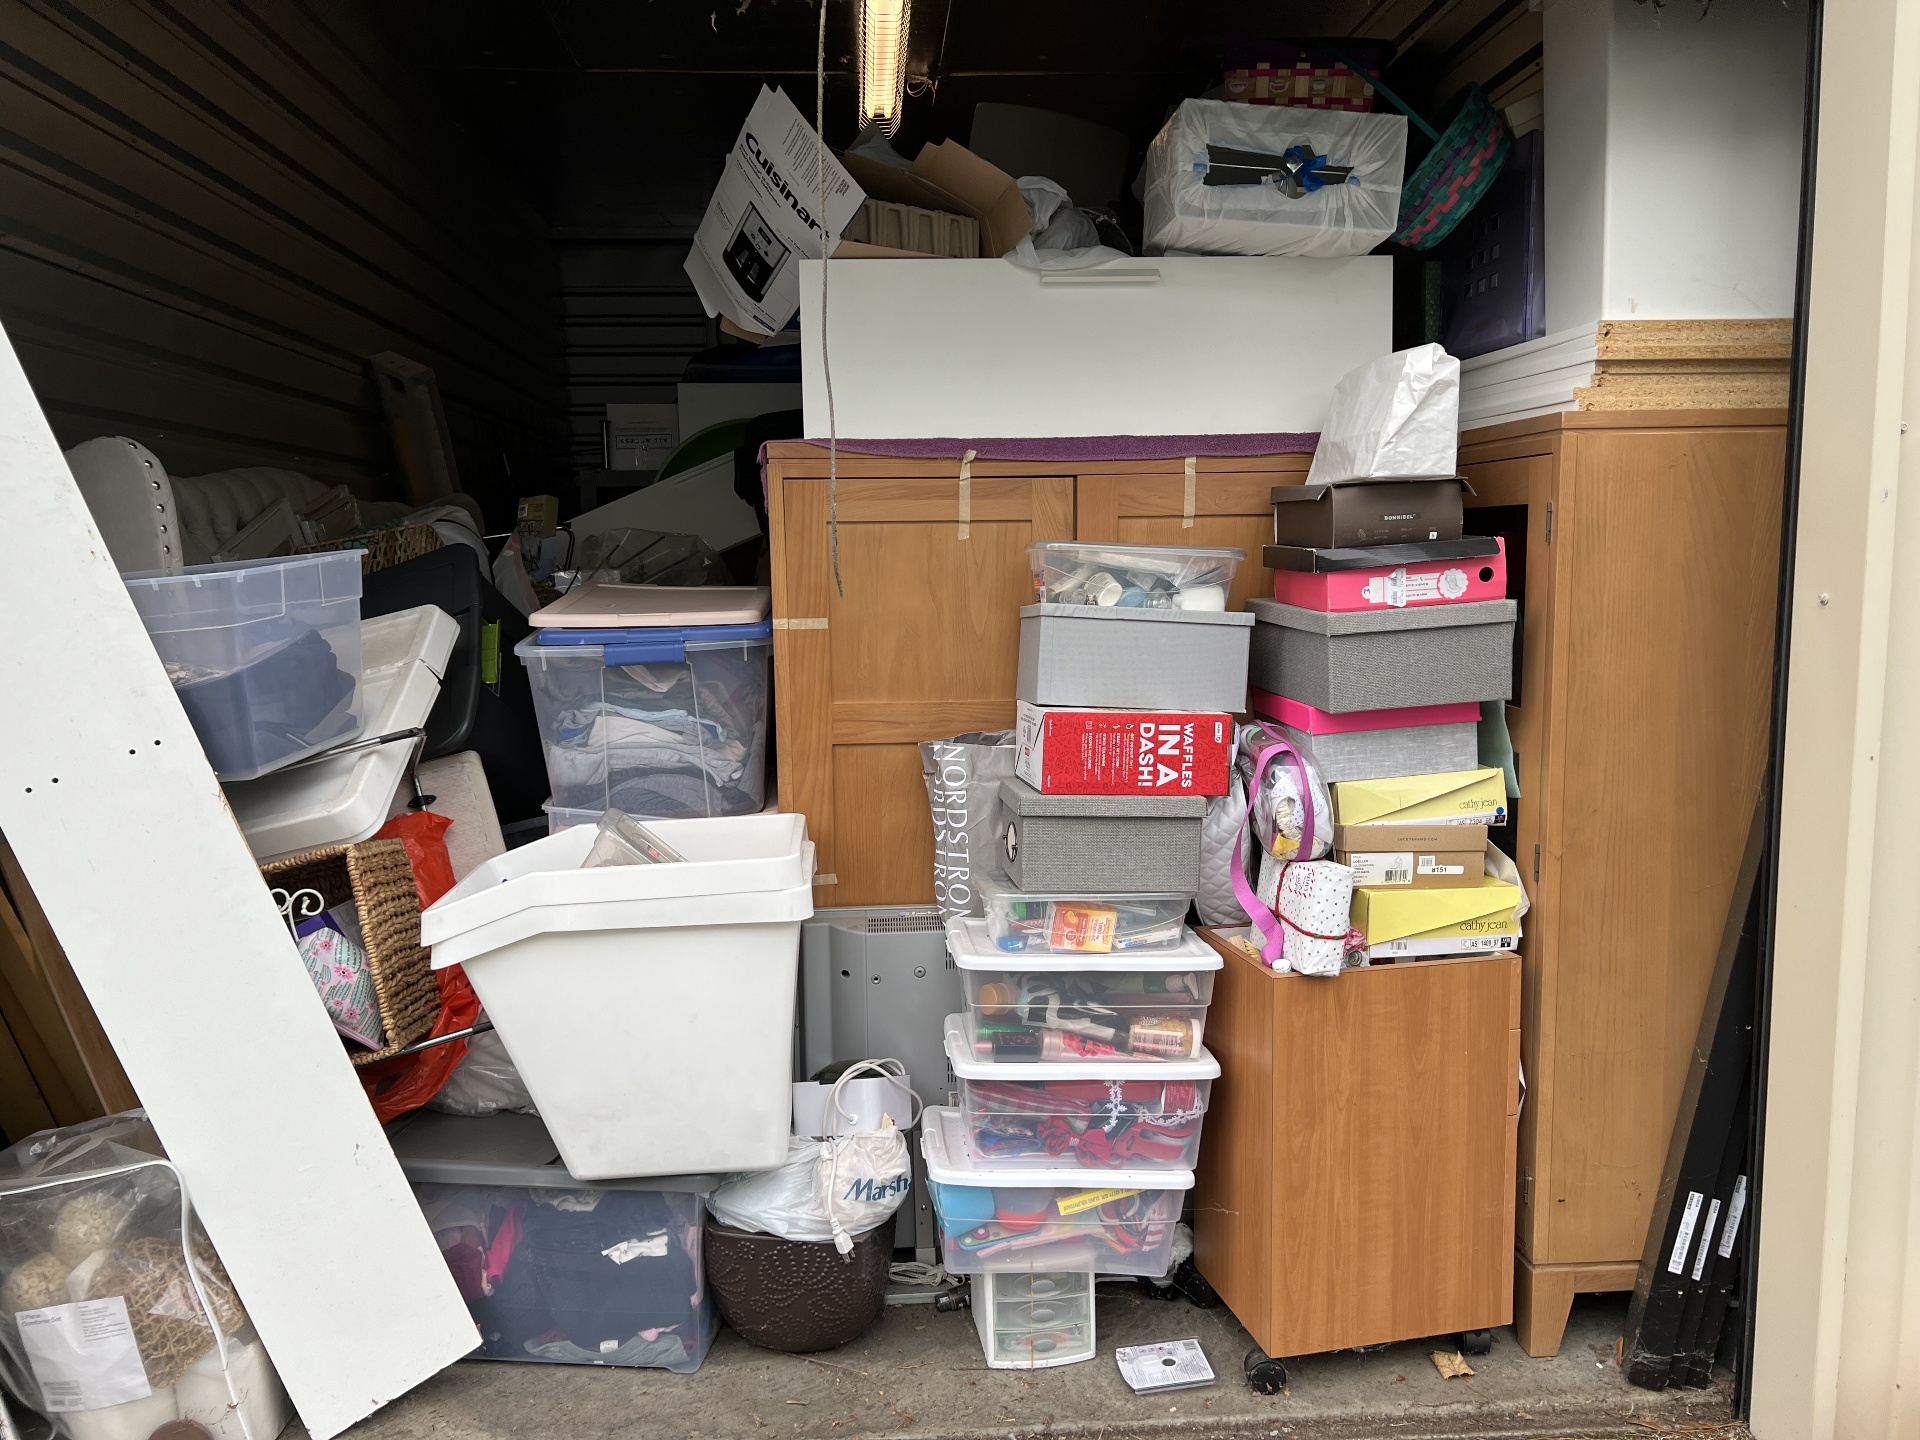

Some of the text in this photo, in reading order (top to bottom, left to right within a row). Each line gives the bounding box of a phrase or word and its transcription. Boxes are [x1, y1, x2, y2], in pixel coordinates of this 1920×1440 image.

[745, 132, 830, 240] Cuisinart
[1138, 722, 1155, 787] DASH!
[1156, 724, 1181, 787] IN A
[1181, 722, 1195, 788] WAFFLES
[1459, 798, 1498, 810] cathy jean
[1460, 919, 1507, 932] cathy jean
[843, 1175, 912, 1201] Marsh
